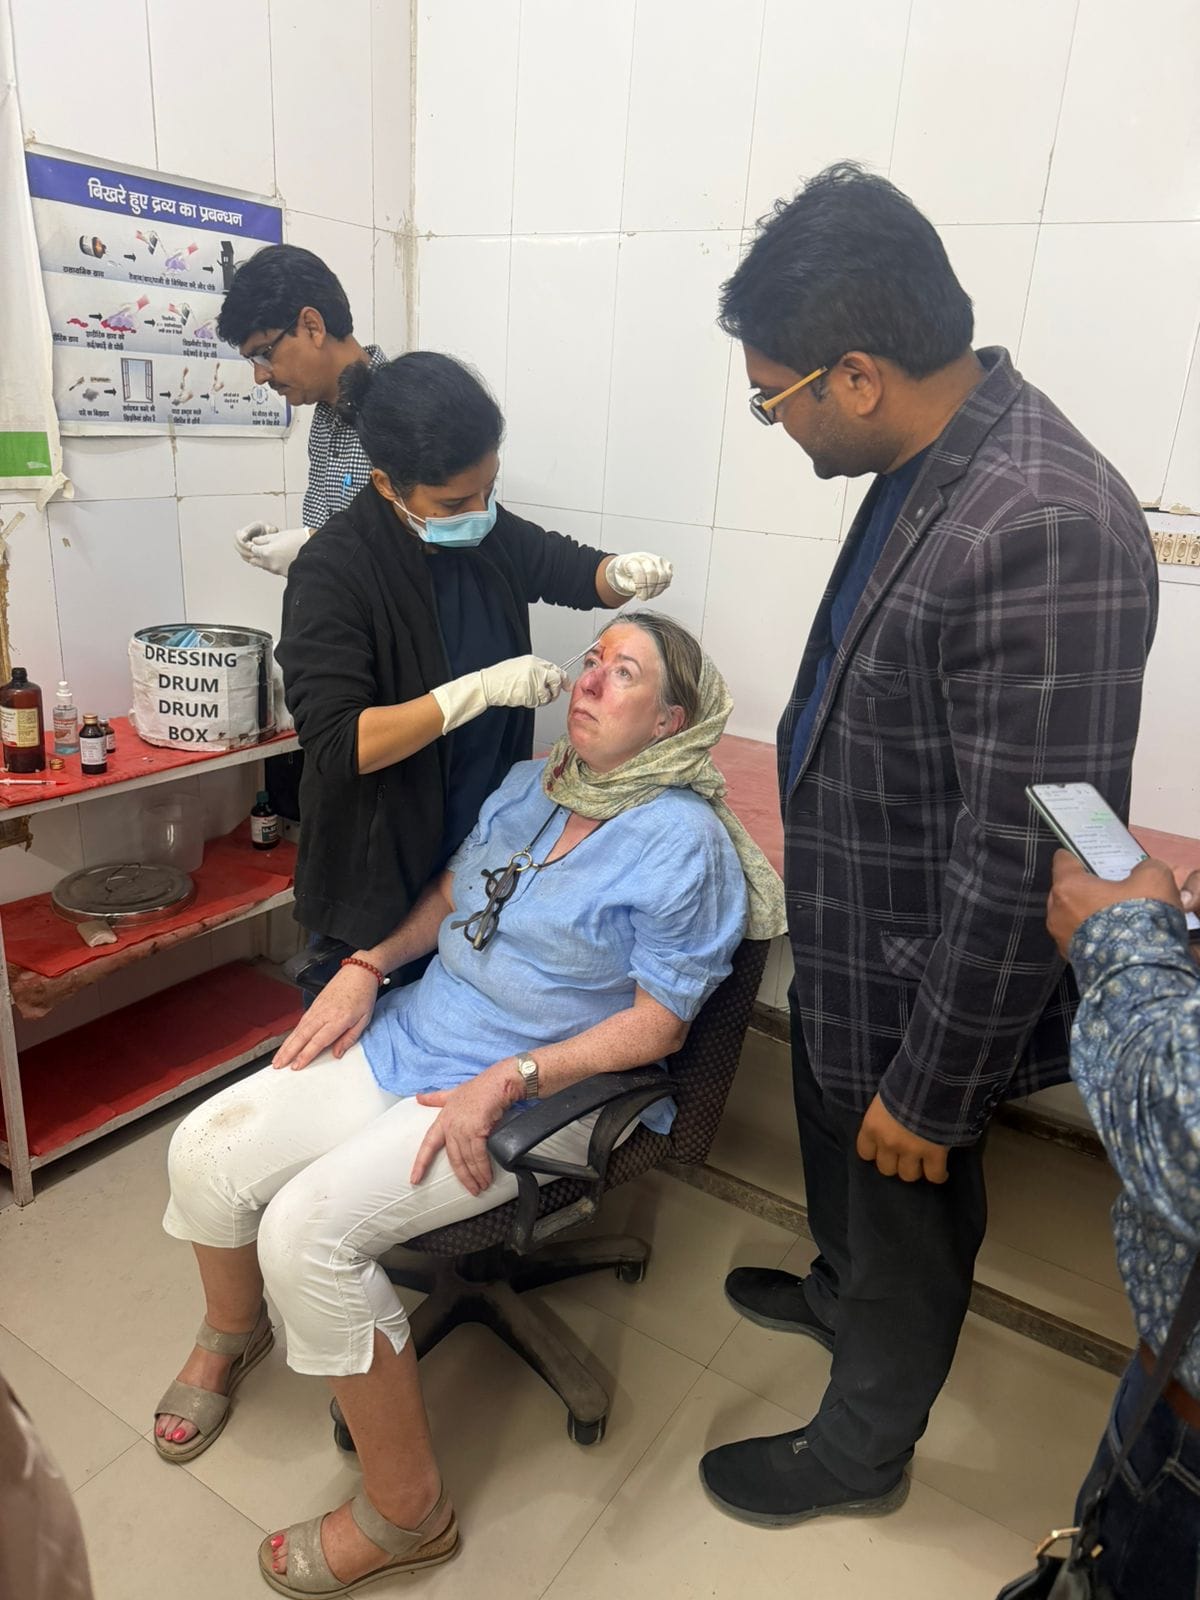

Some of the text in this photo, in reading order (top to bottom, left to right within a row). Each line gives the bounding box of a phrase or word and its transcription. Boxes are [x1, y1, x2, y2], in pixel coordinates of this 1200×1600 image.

[88, 177, 127, 205] बिखरे
[129, 191, 149, 215] हुए
[151, 196, 176, 213] द्रव्य
[179, 201, 197, 218] का
[145, 644, 237, 668] DRESSING
[158, 673, 219, 693] DRUM
[158, 699, 219, 719] DRUM
[168, 725, 209, 743] BOX
